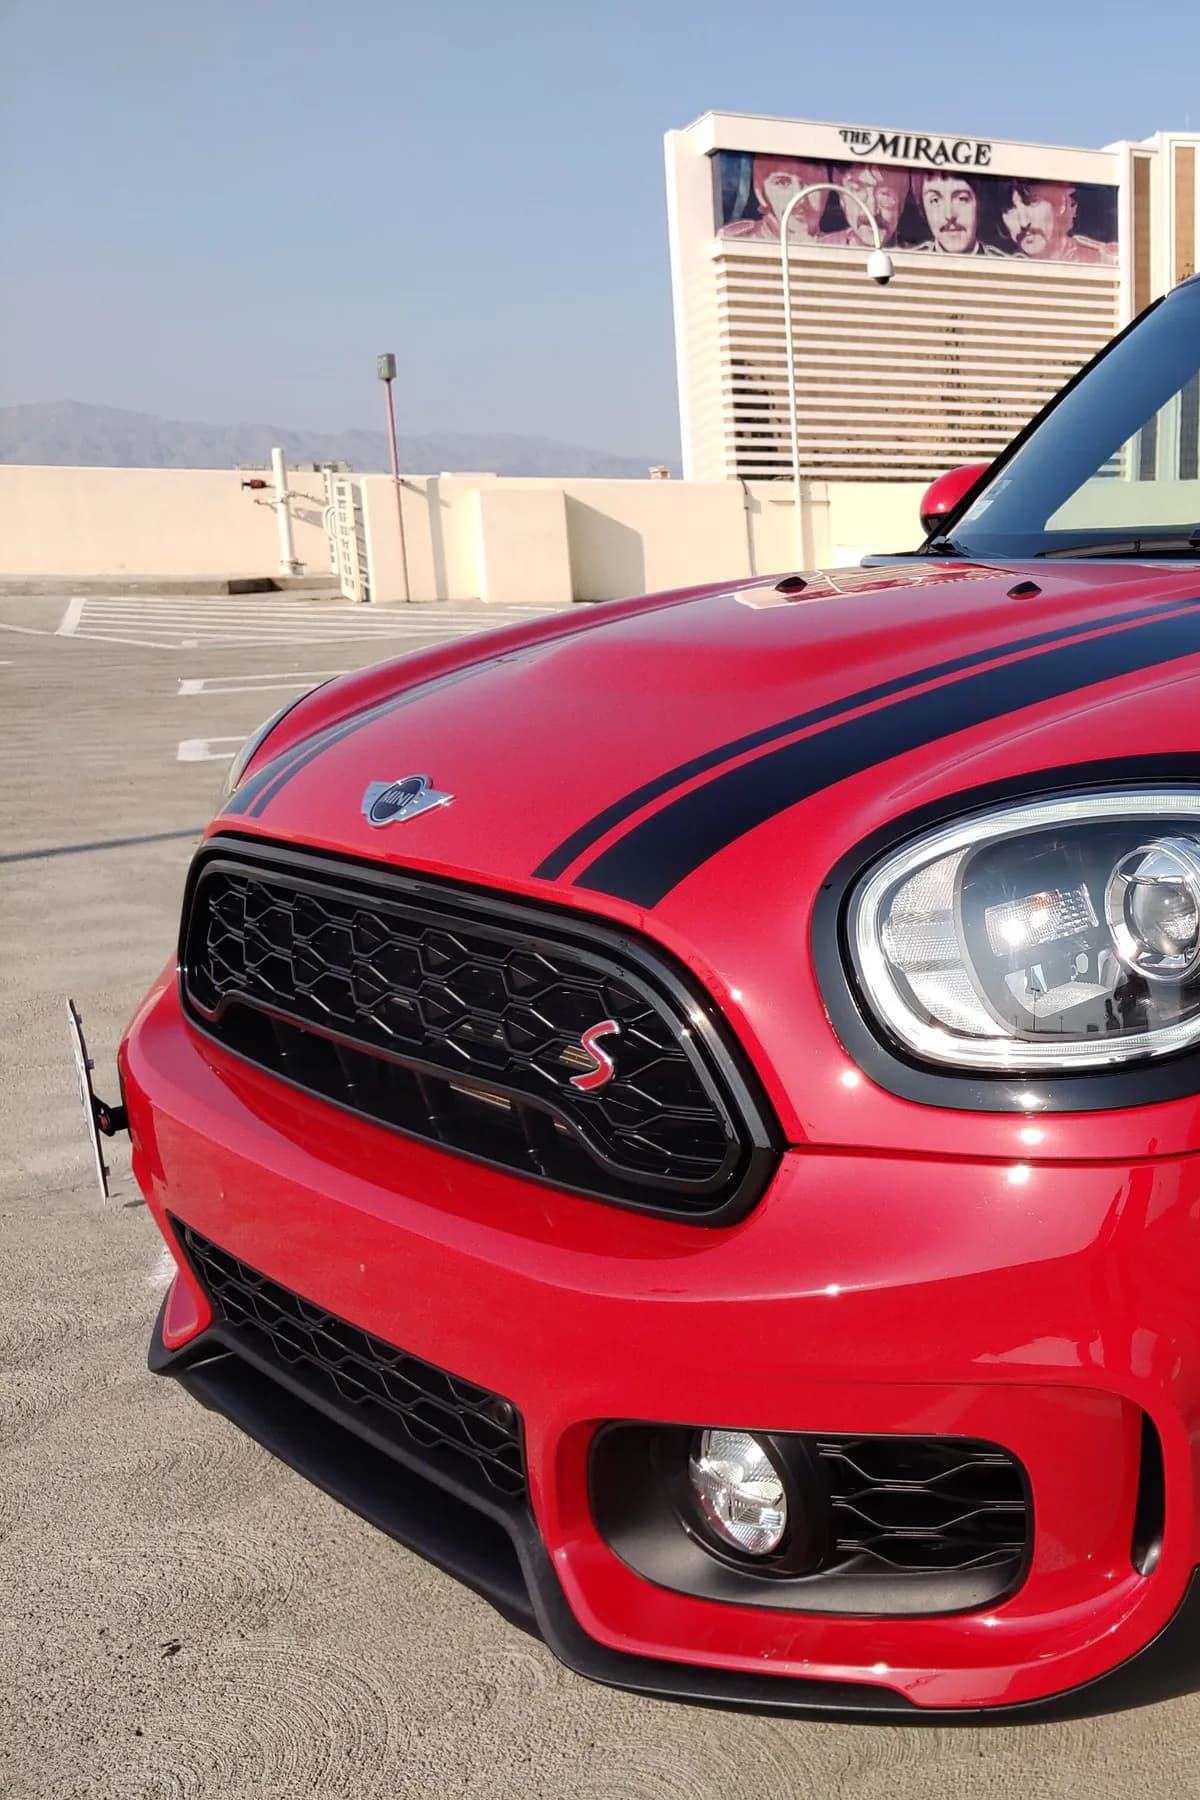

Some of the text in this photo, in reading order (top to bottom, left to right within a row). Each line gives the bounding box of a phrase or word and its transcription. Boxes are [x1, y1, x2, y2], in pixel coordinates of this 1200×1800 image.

[839, 130, 992, 166] THE MIRAGE
[383, 790, 415, 807] MINI
[569, 1019, 622, 1091] S
